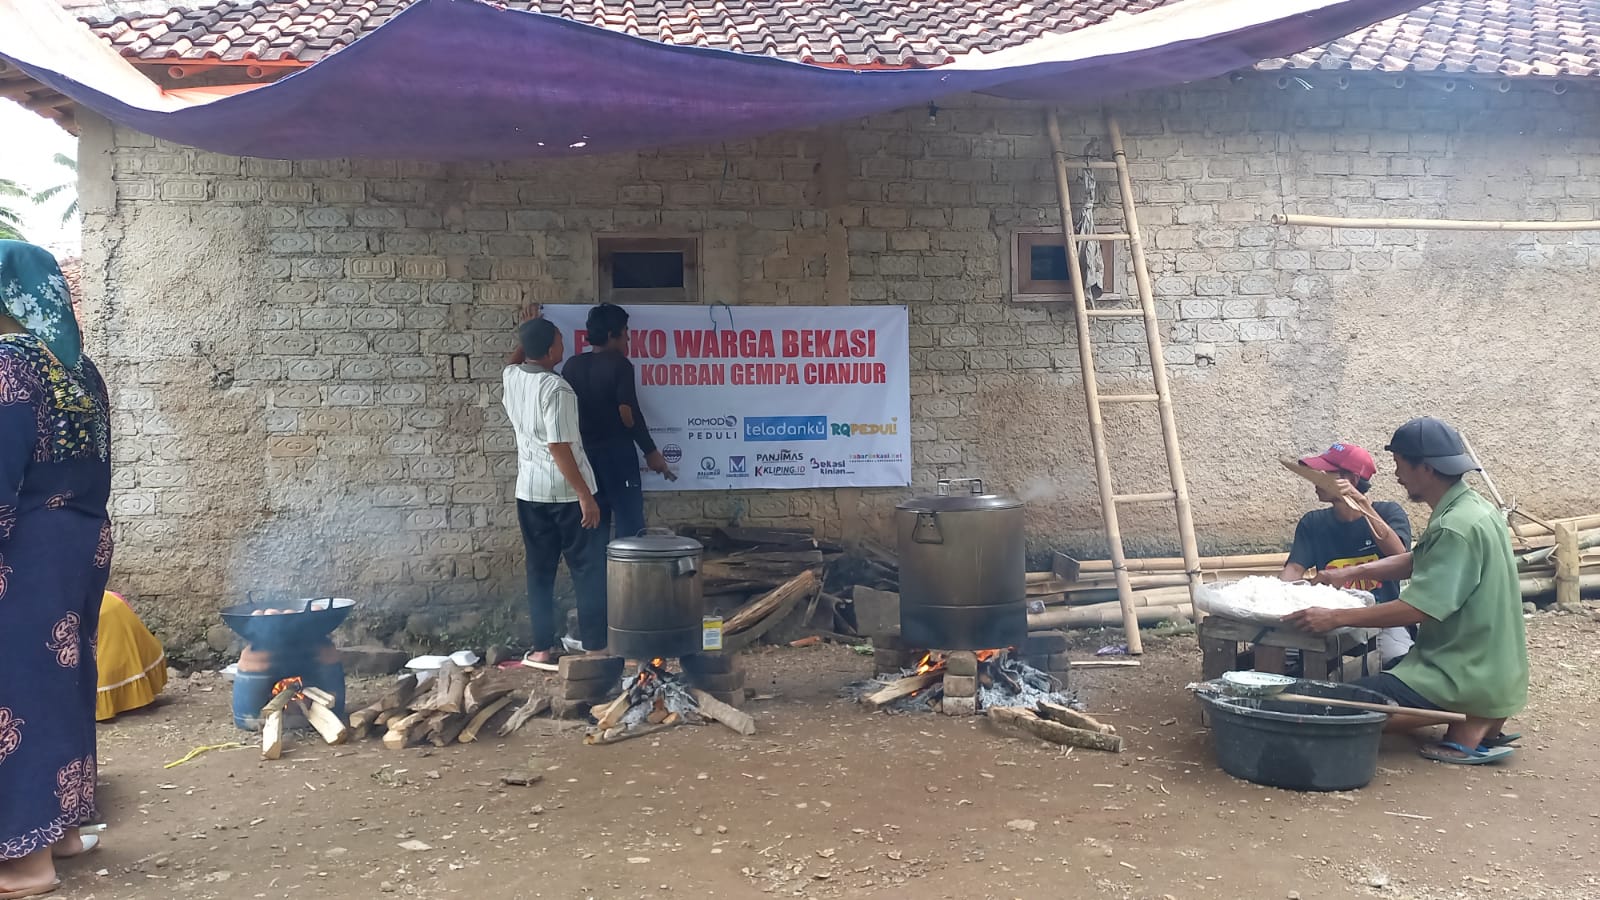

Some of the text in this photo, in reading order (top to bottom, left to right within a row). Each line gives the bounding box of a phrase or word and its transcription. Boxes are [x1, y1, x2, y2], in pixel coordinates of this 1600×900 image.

[574, 328, 876, 358] PKO WARGA BEKASI
[641, 363, 725, 386] KORBAN
[731, 363, 800, 385] GEMPA
[804, 362, 887, 385] CIANJUR
[688, 431, 737, 440] PEDULI
[756, 450, 804, 462] PANJIMAS
